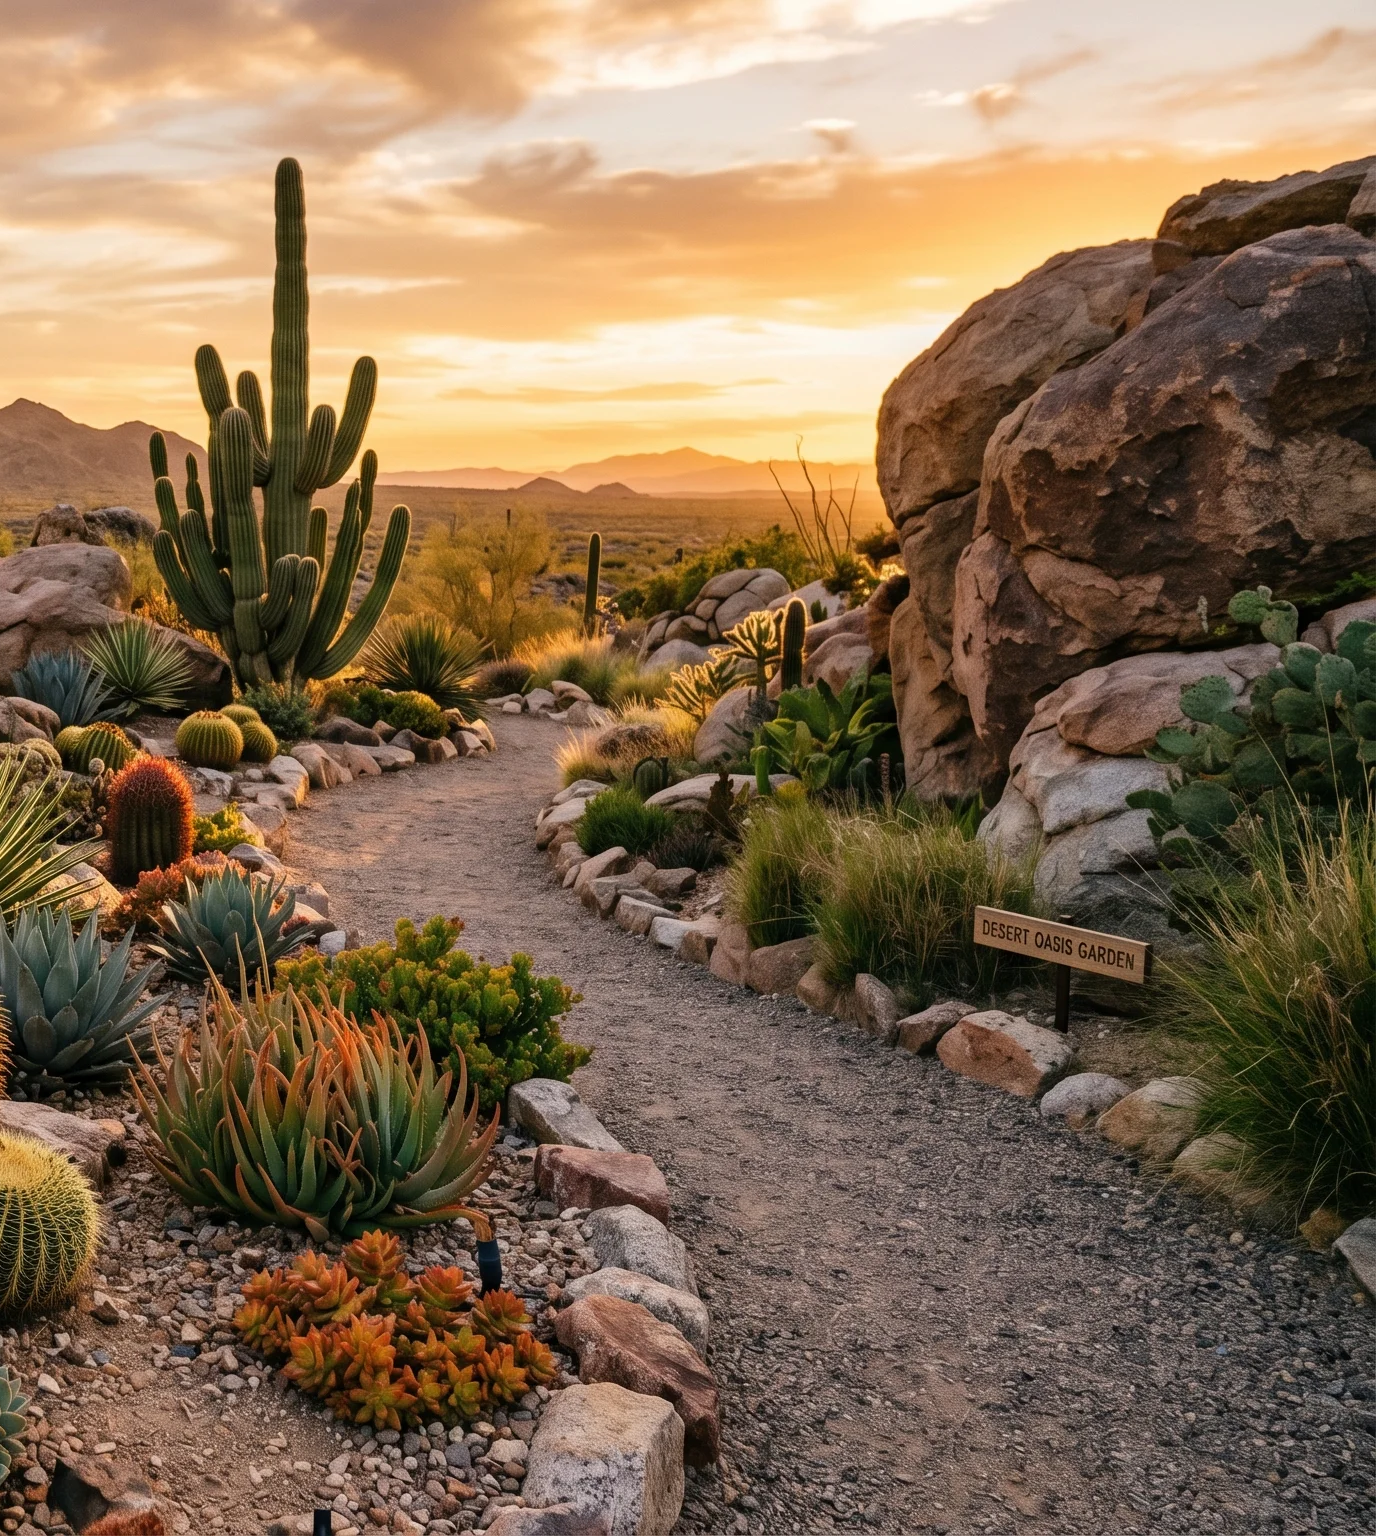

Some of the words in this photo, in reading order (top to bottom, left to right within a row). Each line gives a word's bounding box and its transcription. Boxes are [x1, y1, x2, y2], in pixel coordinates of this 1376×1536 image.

[982, 919, 1030, 945] DESERT
[1034, 931, 1073, 956] OASIS
[1078, 942, 1135, 970] GARDEN
